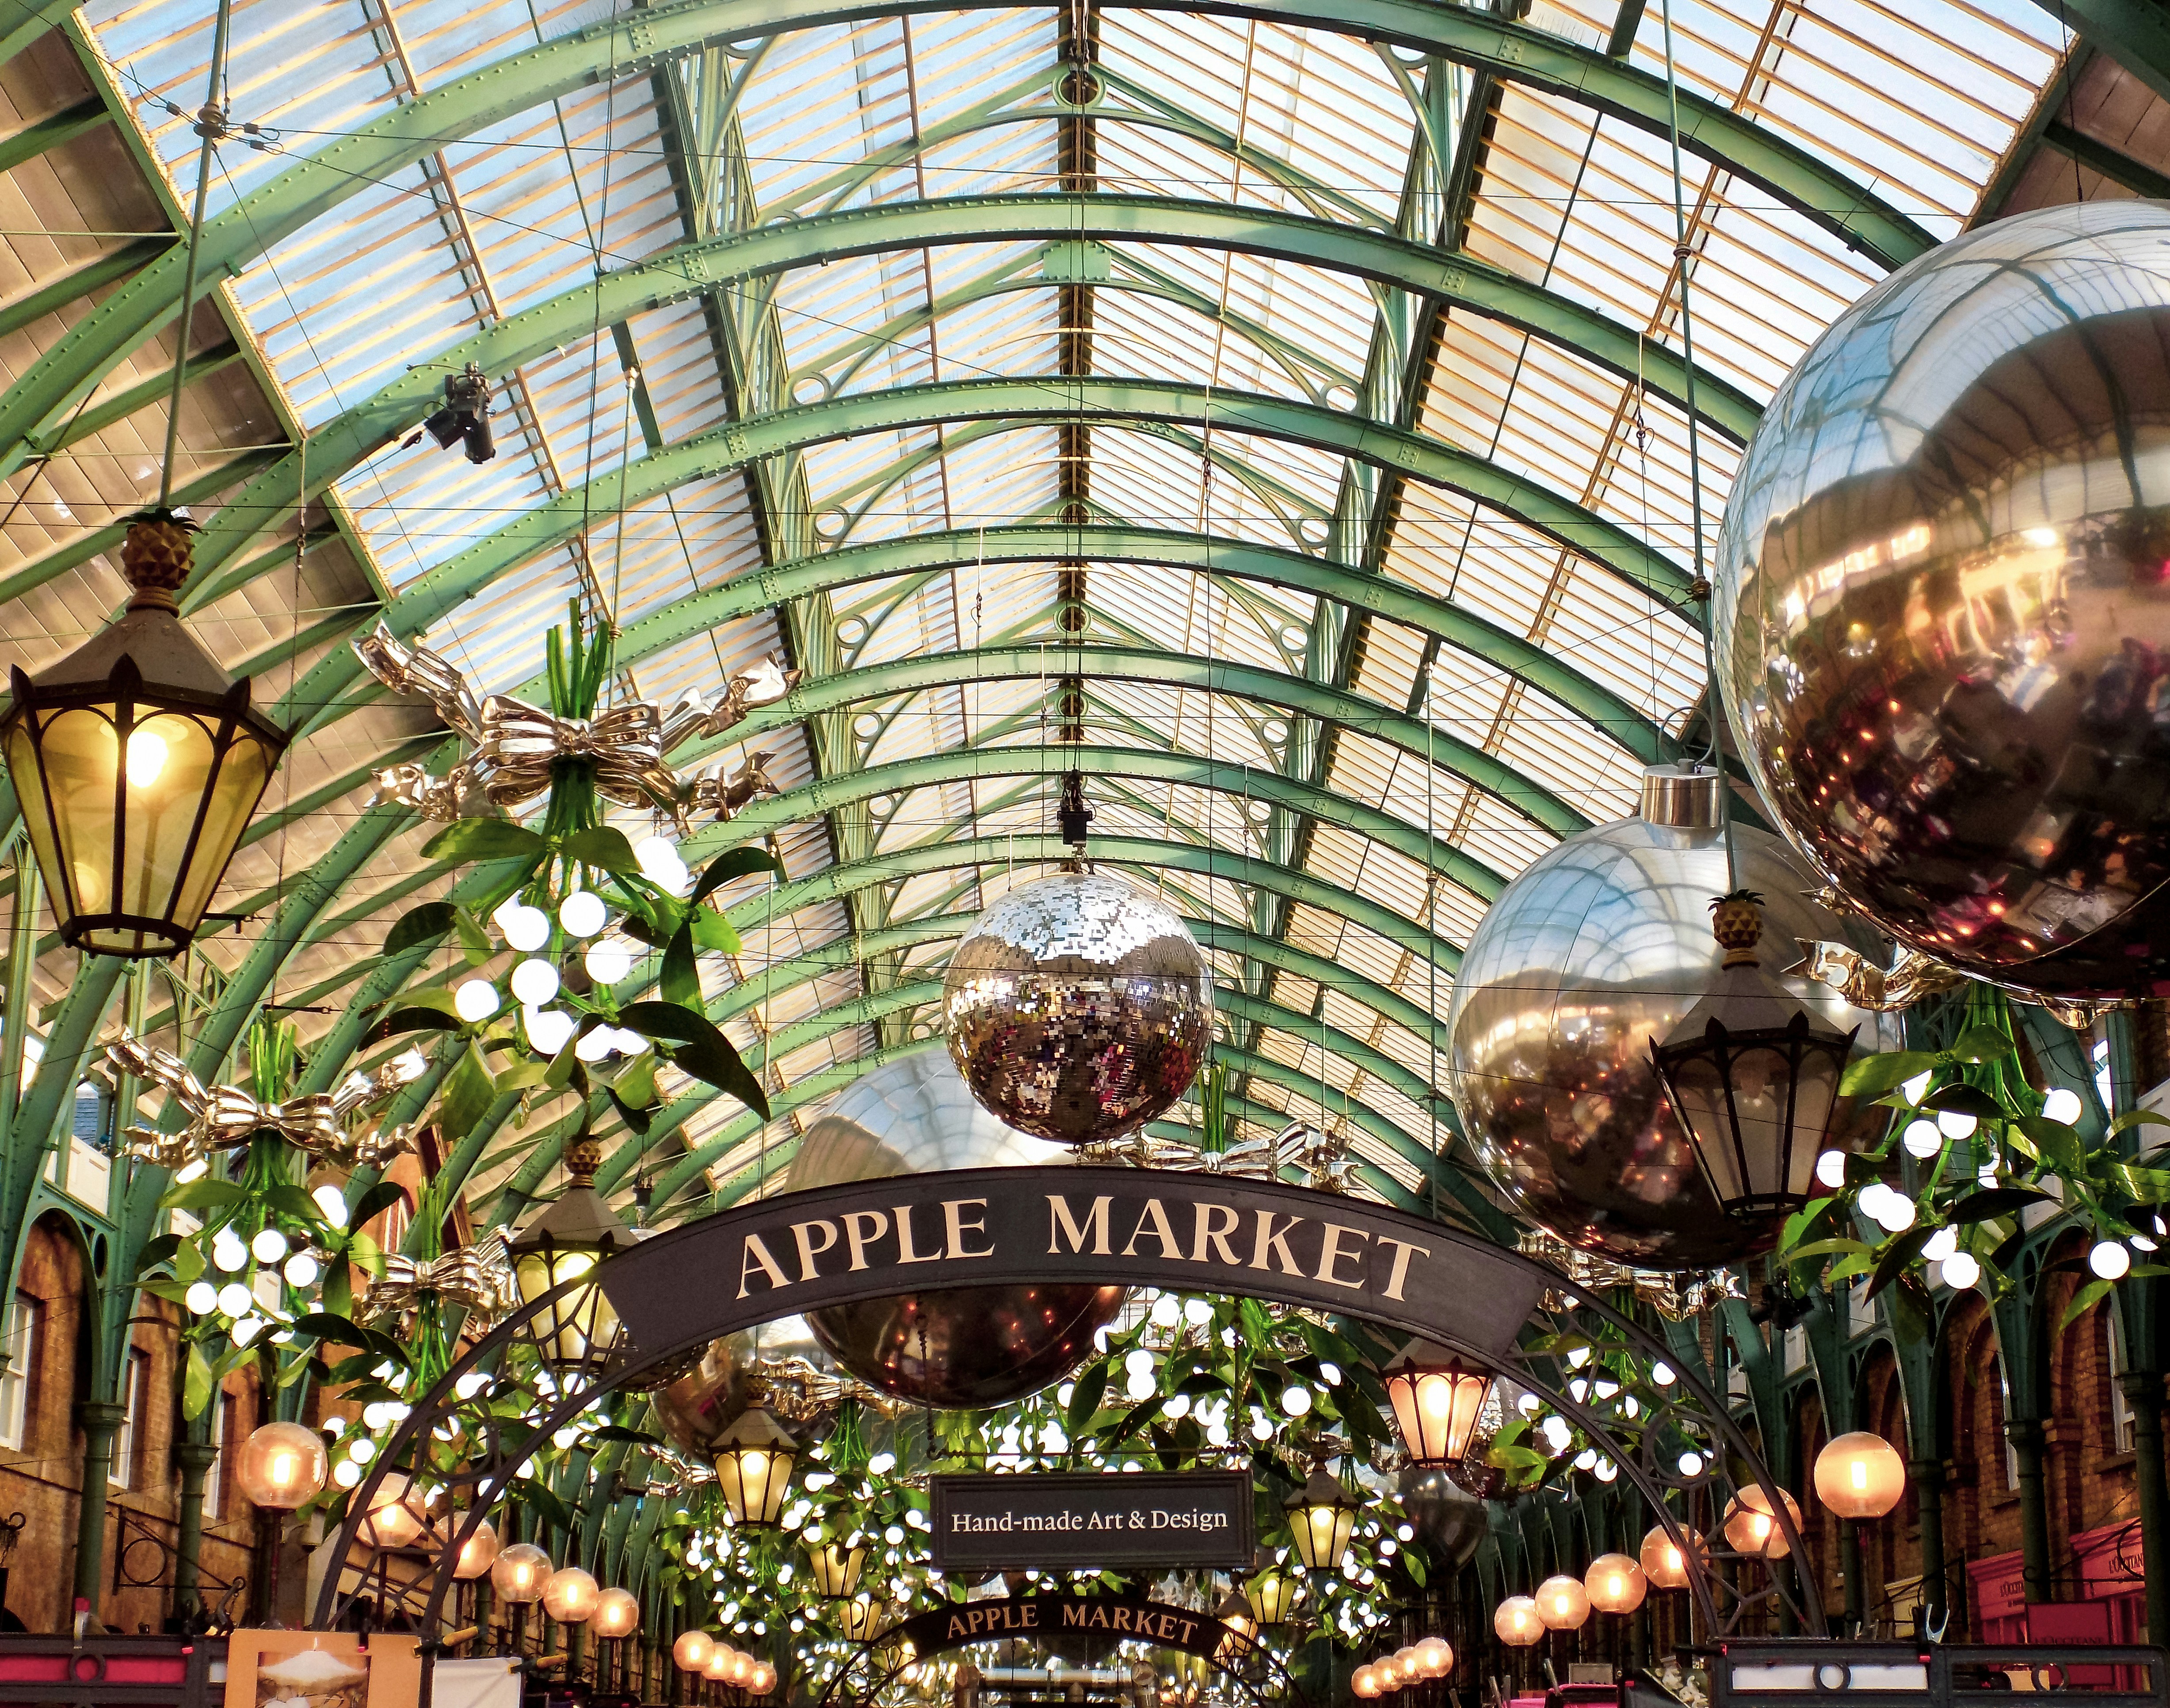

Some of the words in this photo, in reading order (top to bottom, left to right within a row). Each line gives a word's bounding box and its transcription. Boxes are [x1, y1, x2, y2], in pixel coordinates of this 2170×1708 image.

[735, 1197, 995, 1300] APPLE
[1045, 1195, 1431, 1302] MARKET
[951, 1510, 1083, 1533] Hand-made
[1087, 1510, 1124, 1530] Art
[1128, 1510, 1146, 1530] &
[1150, 1508, 1228, 1532] Design
[947, 1605, 1039, 1639] APPLE
[1063, 1604, 1199, 1644] MARKET
